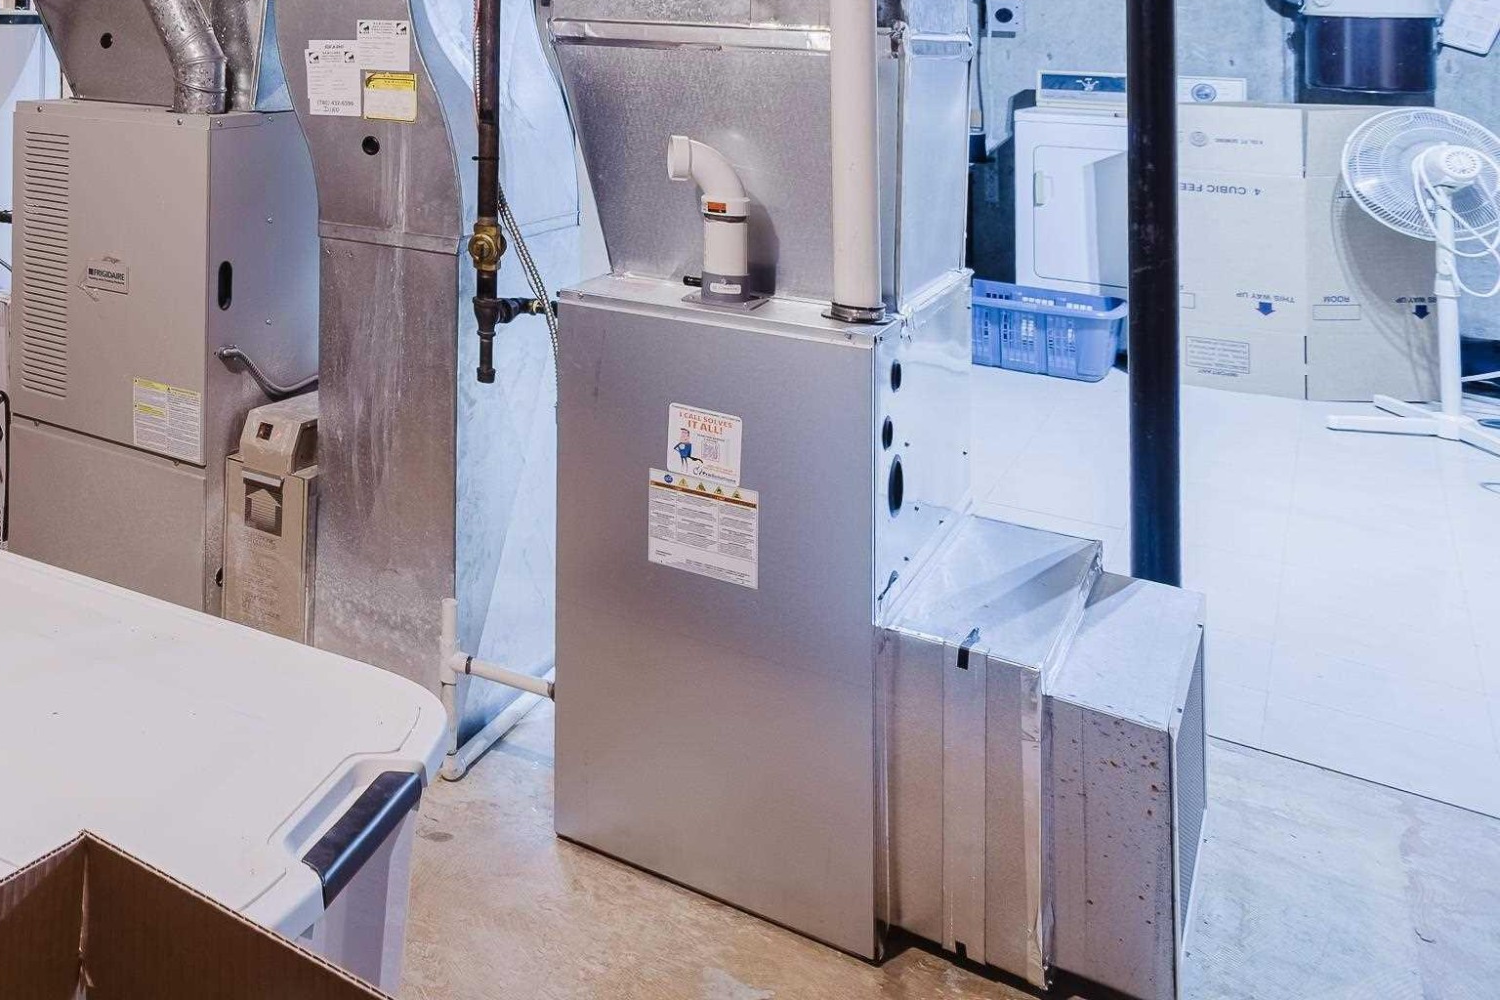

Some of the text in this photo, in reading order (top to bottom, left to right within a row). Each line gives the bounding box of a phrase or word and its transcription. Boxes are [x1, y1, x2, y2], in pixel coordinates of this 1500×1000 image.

[1180, 182, 1261, 196] 4 CUBIC FEE
[1251, 292, 1271, 301] WAY
[1273, 294, 1295, 303] THIS
[1323, 295, 1350, 303] ROOM
[687, 420, 698, 429] IT
